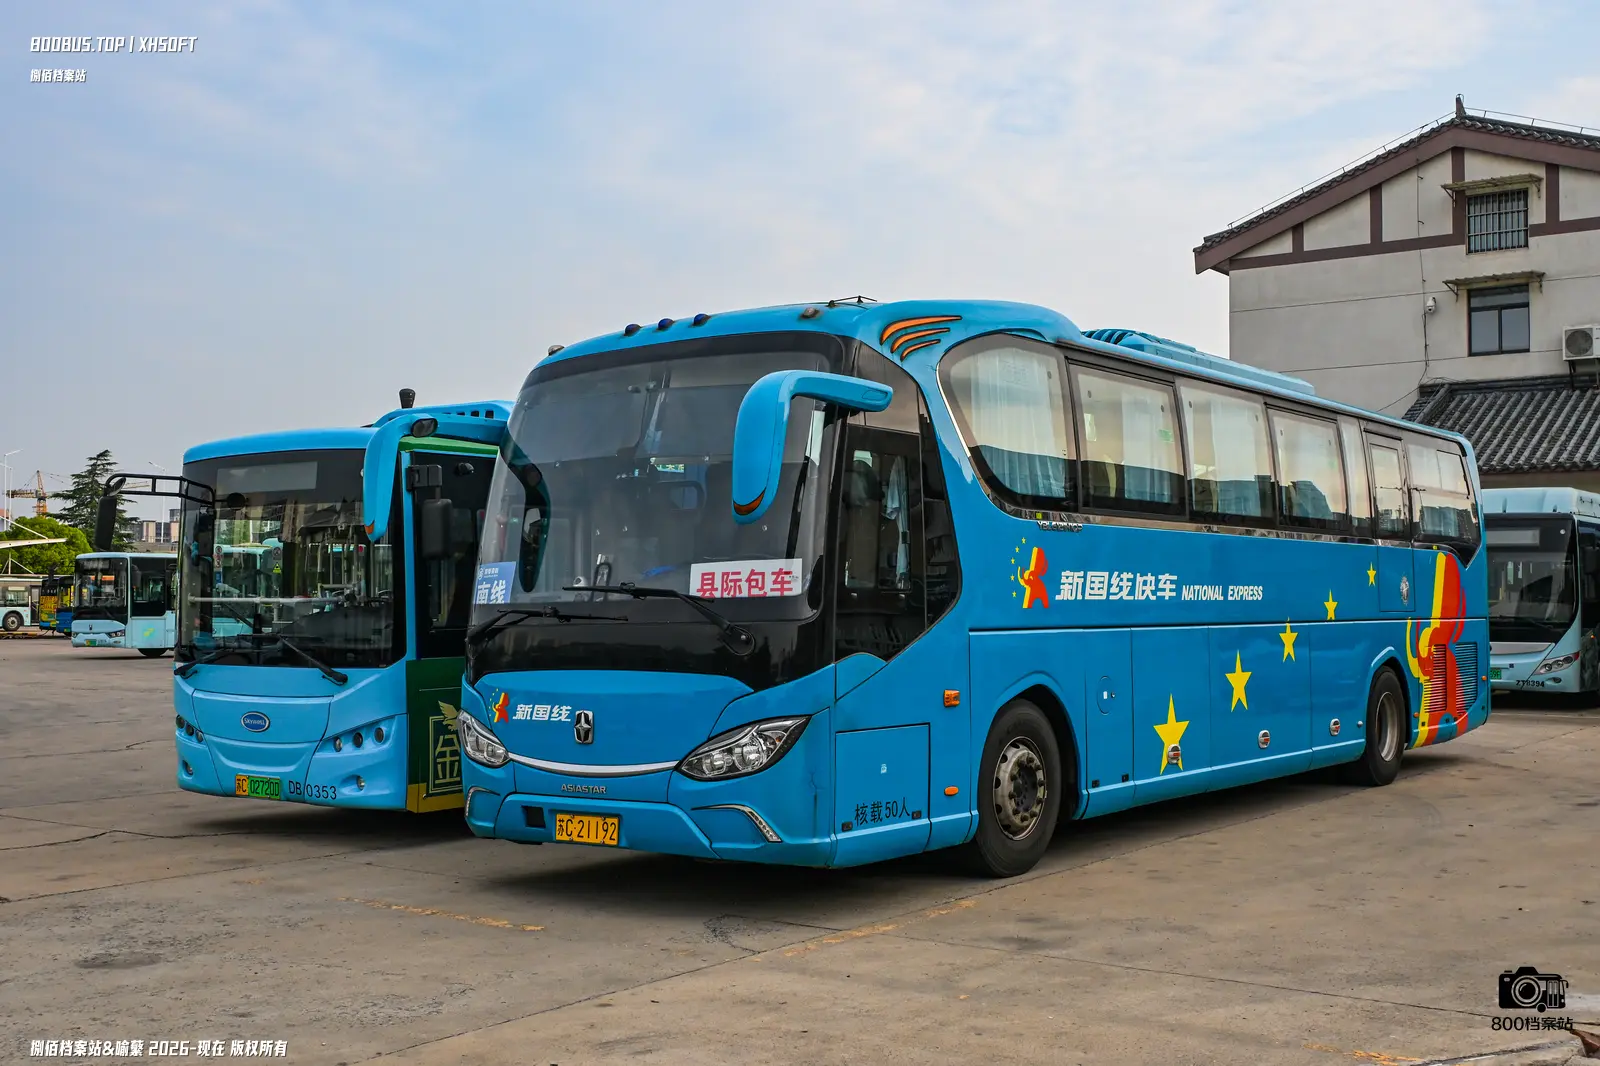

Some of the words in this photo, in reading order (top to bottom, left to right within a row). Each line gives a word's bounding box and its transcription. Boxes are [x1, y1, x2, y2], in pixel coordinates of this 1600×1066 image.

[696, 568, 793, 598] 县际包车
[1055, 570, 1178, 600] 新国线快车
[1181, 585, 1224, 601] NATIONAL
[1227, 585, 1263, 601] EXPRESS
[512, 704, 572, 722] 新国线
[561, 784, 606, 794] ASIASTAR
[855, 797, 910, 826] 核载50人
